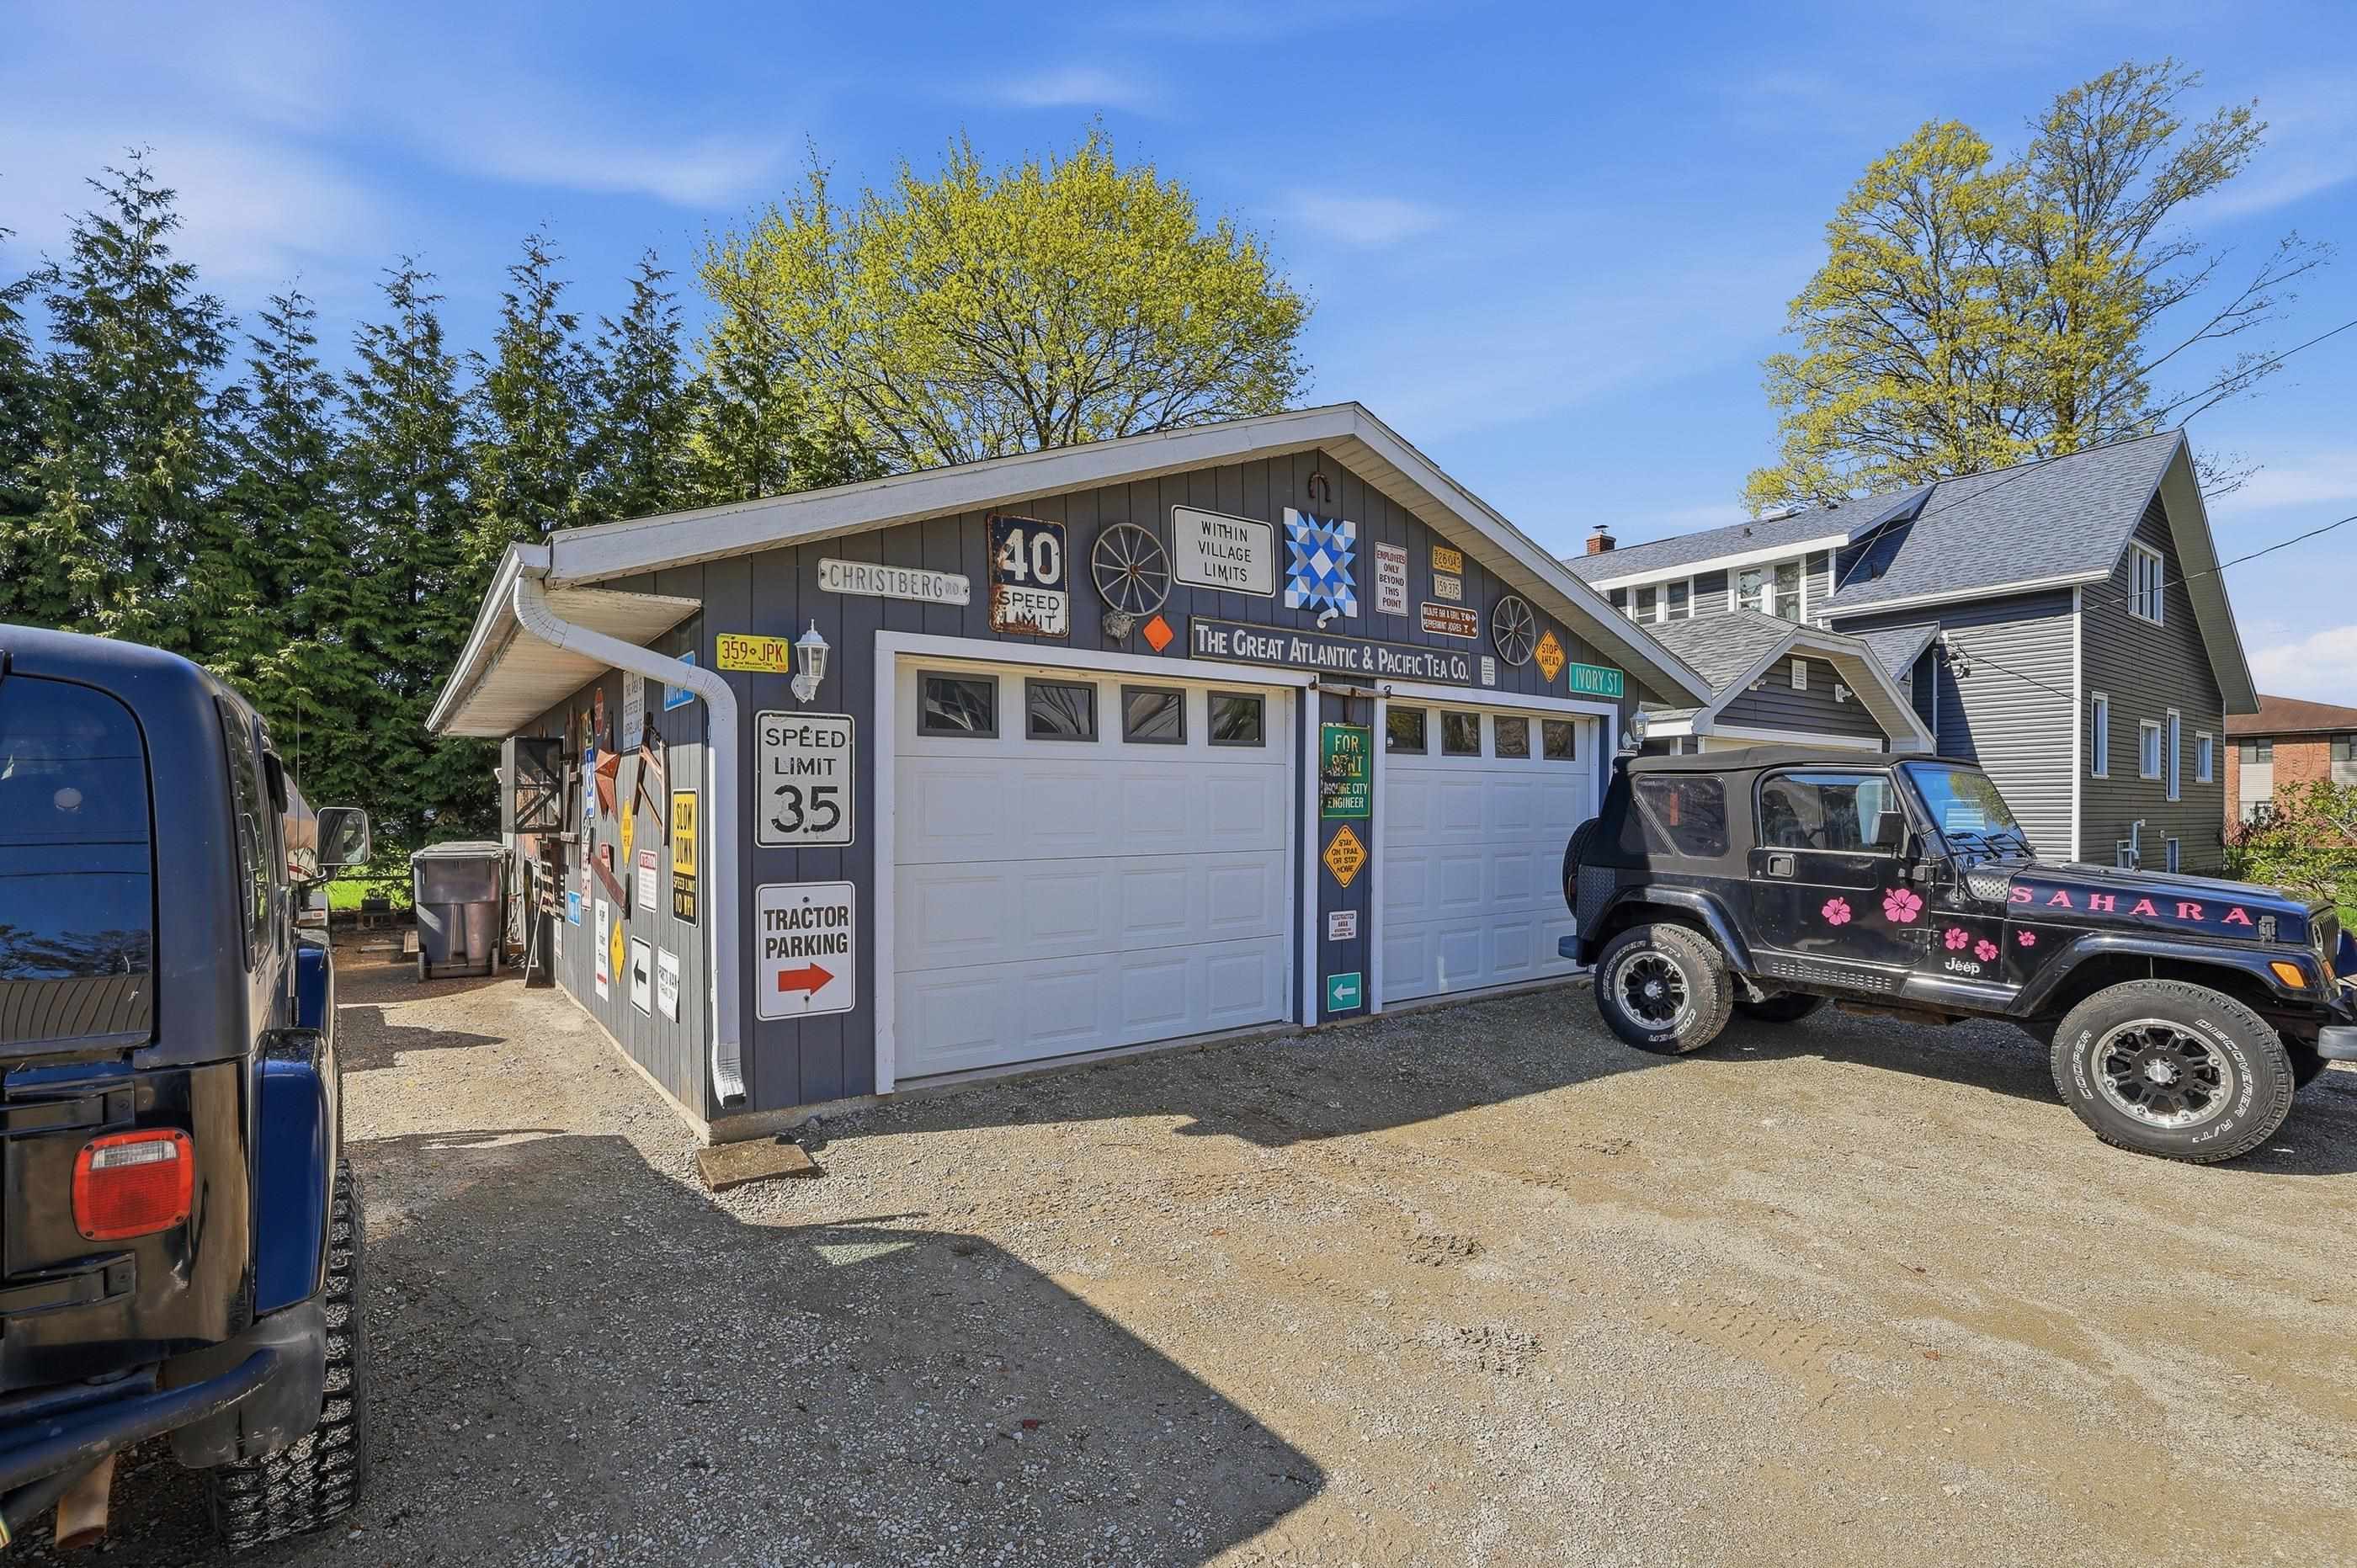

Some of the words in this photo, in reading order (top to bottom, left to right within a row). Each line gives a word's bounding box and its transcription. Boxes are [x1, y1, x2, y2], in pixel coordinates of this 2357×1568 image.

[1201, 520, 1248, 543] WITHIN
[997, 529, 1061, 585] 40
[1198, 539, 1252, 563] VILLAGE
[1204, 561, 1248, 582] LIMITS
[1383, 563, 1400, 573] ONLY
[830, 565, 943, 598] CHRISTBERG
[1379, 574, 1405, 587] BEYOND
[999, 591, 1060, 611] SPEED
[1382, 597, 1402, 609] POINT
[1385, 587, 1400, 597] THIS
[1003, 610, 1057, 630] LIMIT
[721, 640, 748, 660] 359
[758, 643, 783, 663] JPK
[1195, 625, 1228, 654] THE
[1232, 629, 1285, 661] GREAT
[1289, 636, 1358, 669] ATLANTIC
[1362, 646, 1374, 671] &
[1378, 647, 1423, 676] PACIFIC
[1424, 653, 1448, 678] TEA
[1450, 656, 1469, 681] CO.
[1541, 643, 1558, 655] STOP
[1541, 656, 1559, 667] AHEAD
[1576, 667, 1604, 692] IVORY
[1608, 672, 1619, 694] ST
[765, 727, 846, 748] SPEED
[1335, 735, 1359, 753] FOR
[774, 757, 837, 776] LIMIT
[1353, 783, 1368, 795] CITY
[771, 784, 841, 833] 35
[1327, 797, 1364, 809] ENGINEER
[676, 803, 693, 831] SLOW
[675, 836, 693, 866] DOWN
[2009, 886, 2253, 927] SAHARA
[763, 906, 849, 931] TRACTOR
[765, 932, 849, 959] PARKING
[1945, 957, 1981, 976] Jeep
[2072, 1029, 2094, 1100] COOPER
[2195, 1019, 2253, 1119] DISCOVERER
